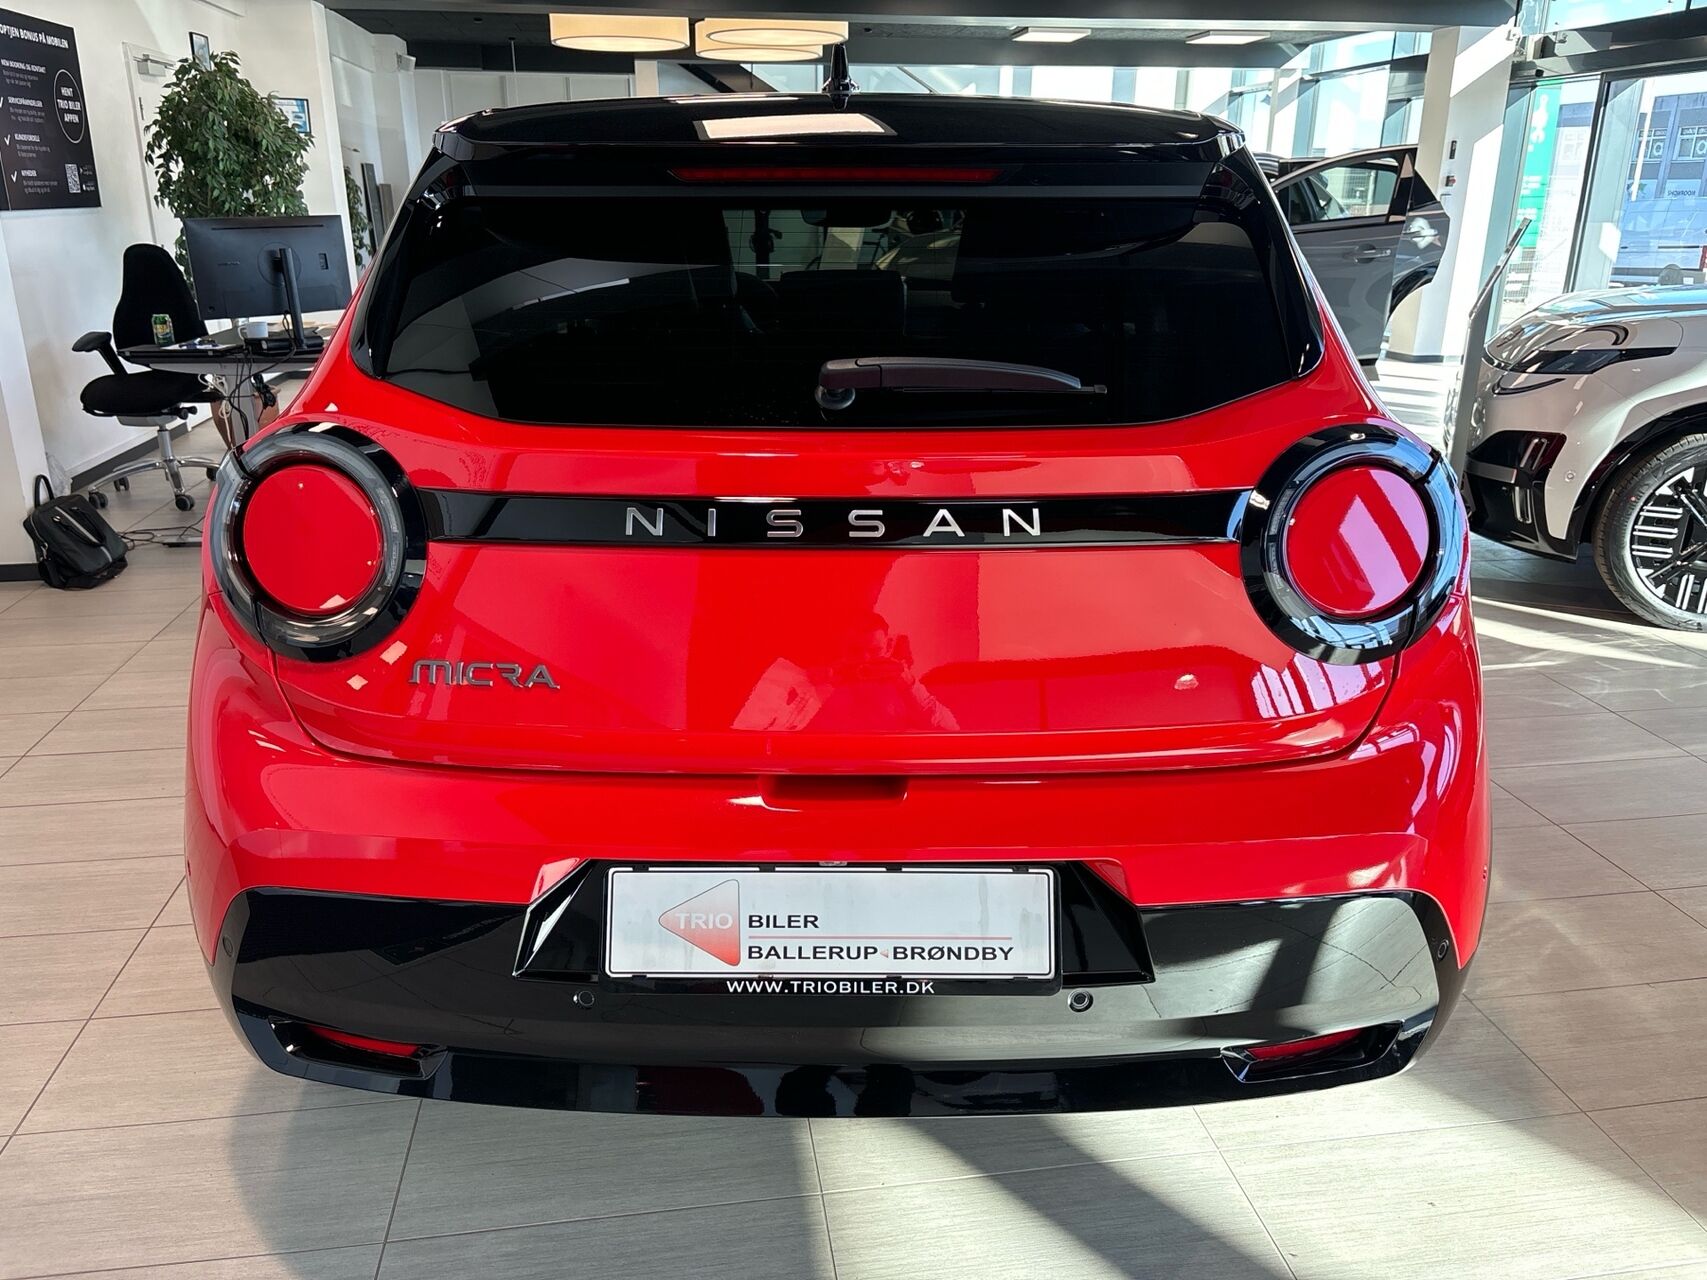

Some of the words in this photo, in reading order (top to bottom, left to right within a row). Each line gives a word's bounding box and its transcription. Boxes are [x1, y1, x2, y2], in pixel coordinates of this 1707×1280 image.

[19, 28, 38, 42] BONUS
[39, 31, 46, 44] PÅ
[46, 35, 69, 49] MOBILEN
[57, 98, 68, 109] TRIO
[68, 101, 81, 111] BILER
[624, 507, 1042, 538] NISSAN
[408, 659, 560, 690] MICRA
[675, 912, 734, 930] TRIO
[748, 913, 820, 929] BILER
[748, 945, 878, 961] BALLERUP
[893, 944, 1014, 962] BRØNDBY
[726, 980, 936, 995] WWW.TRIOBILER.DK
